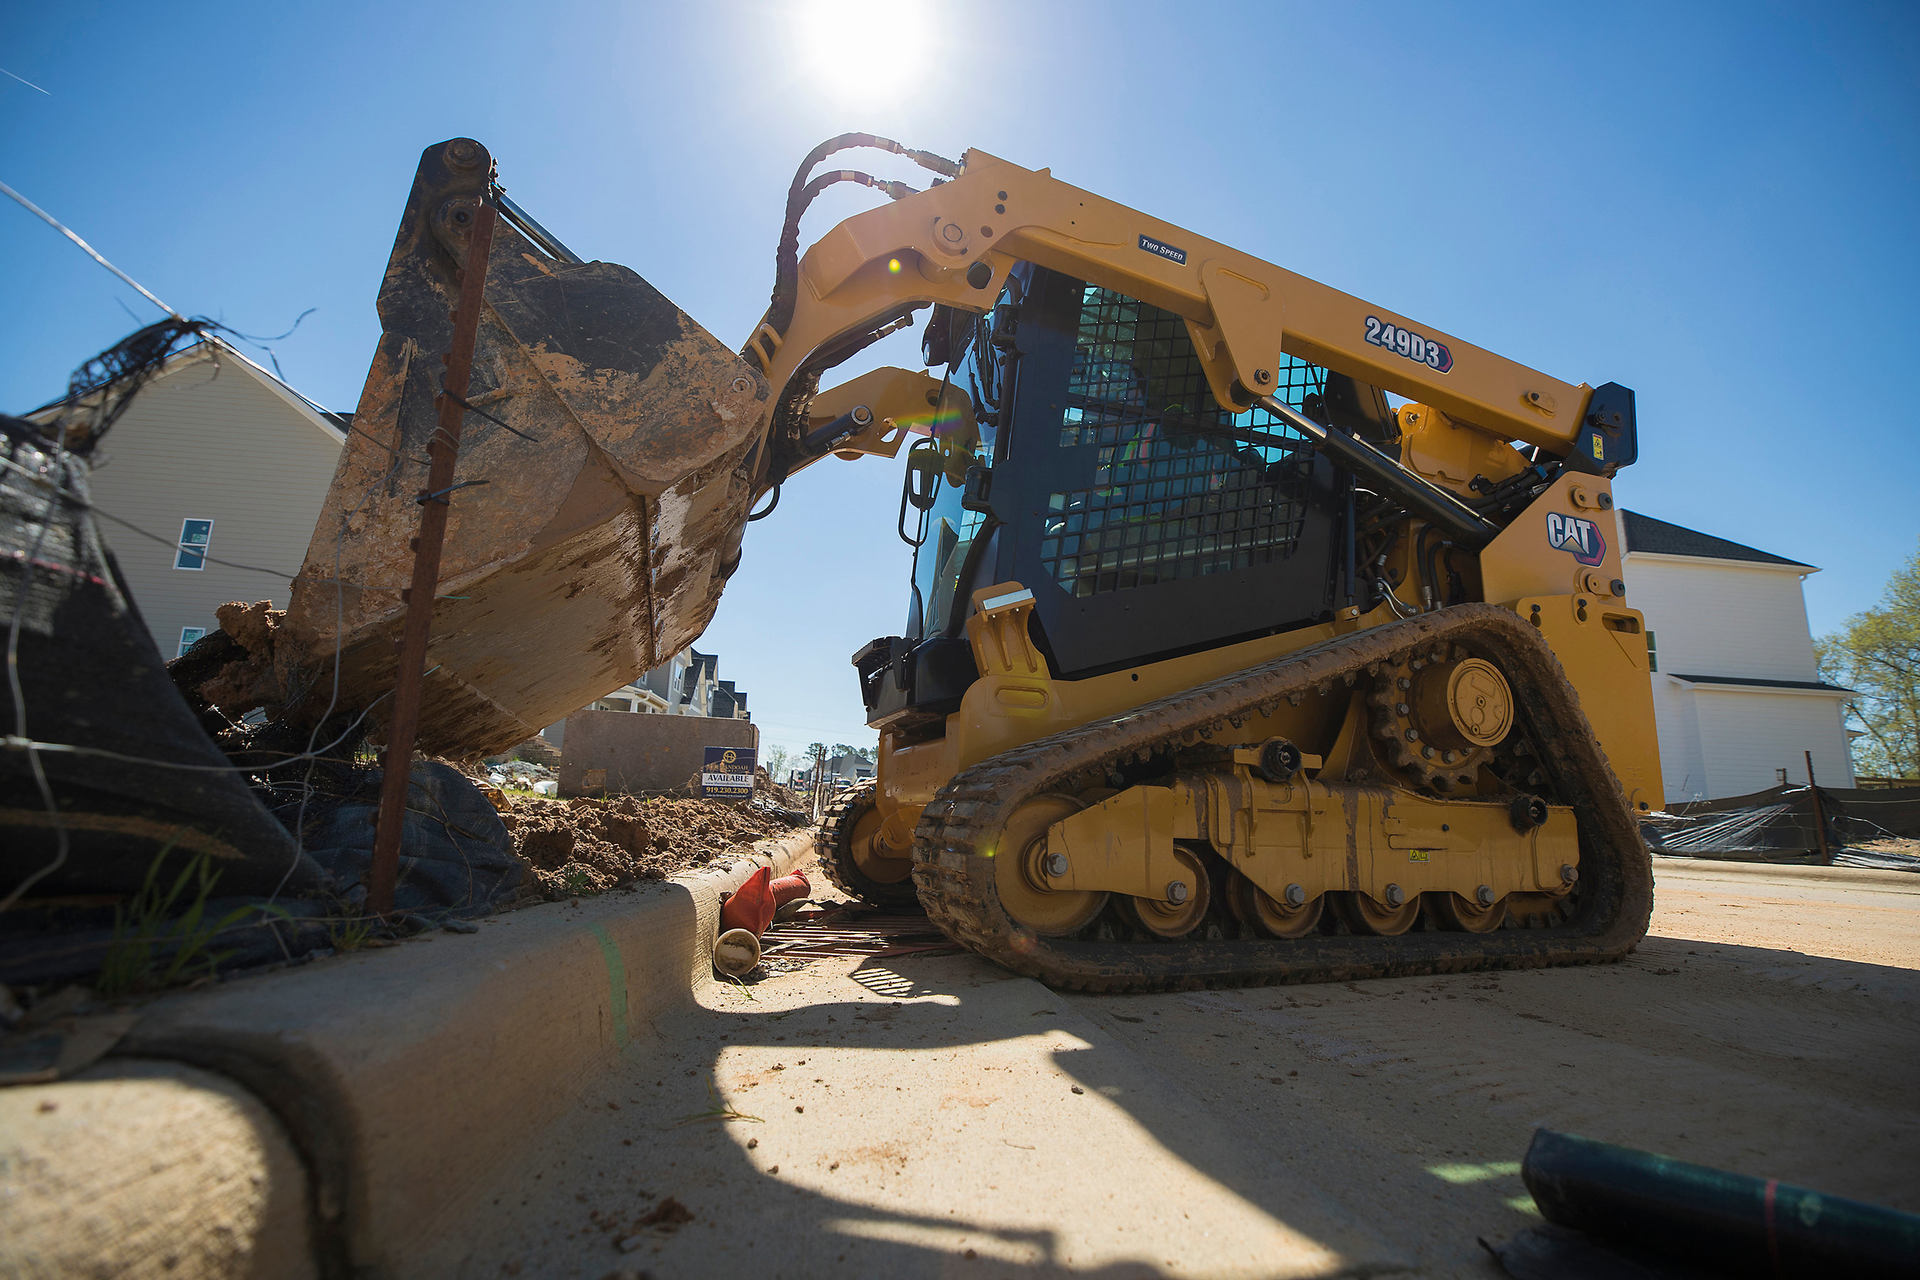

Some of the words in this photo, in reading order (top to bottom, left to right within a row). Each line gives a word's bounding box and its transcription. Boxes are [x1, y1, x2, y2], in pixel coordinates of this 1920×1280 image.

[1142, 238, 1159, 252] TWO
[1160, 246, 1184, 261] SPEED
[1365, 316, 1440, 368] 249D3
[1547, 513, 1591, 555] CAT
[705, 786, 749, 794] 919.230.2300
[707, 774, 749, 783] AVAILABLE
